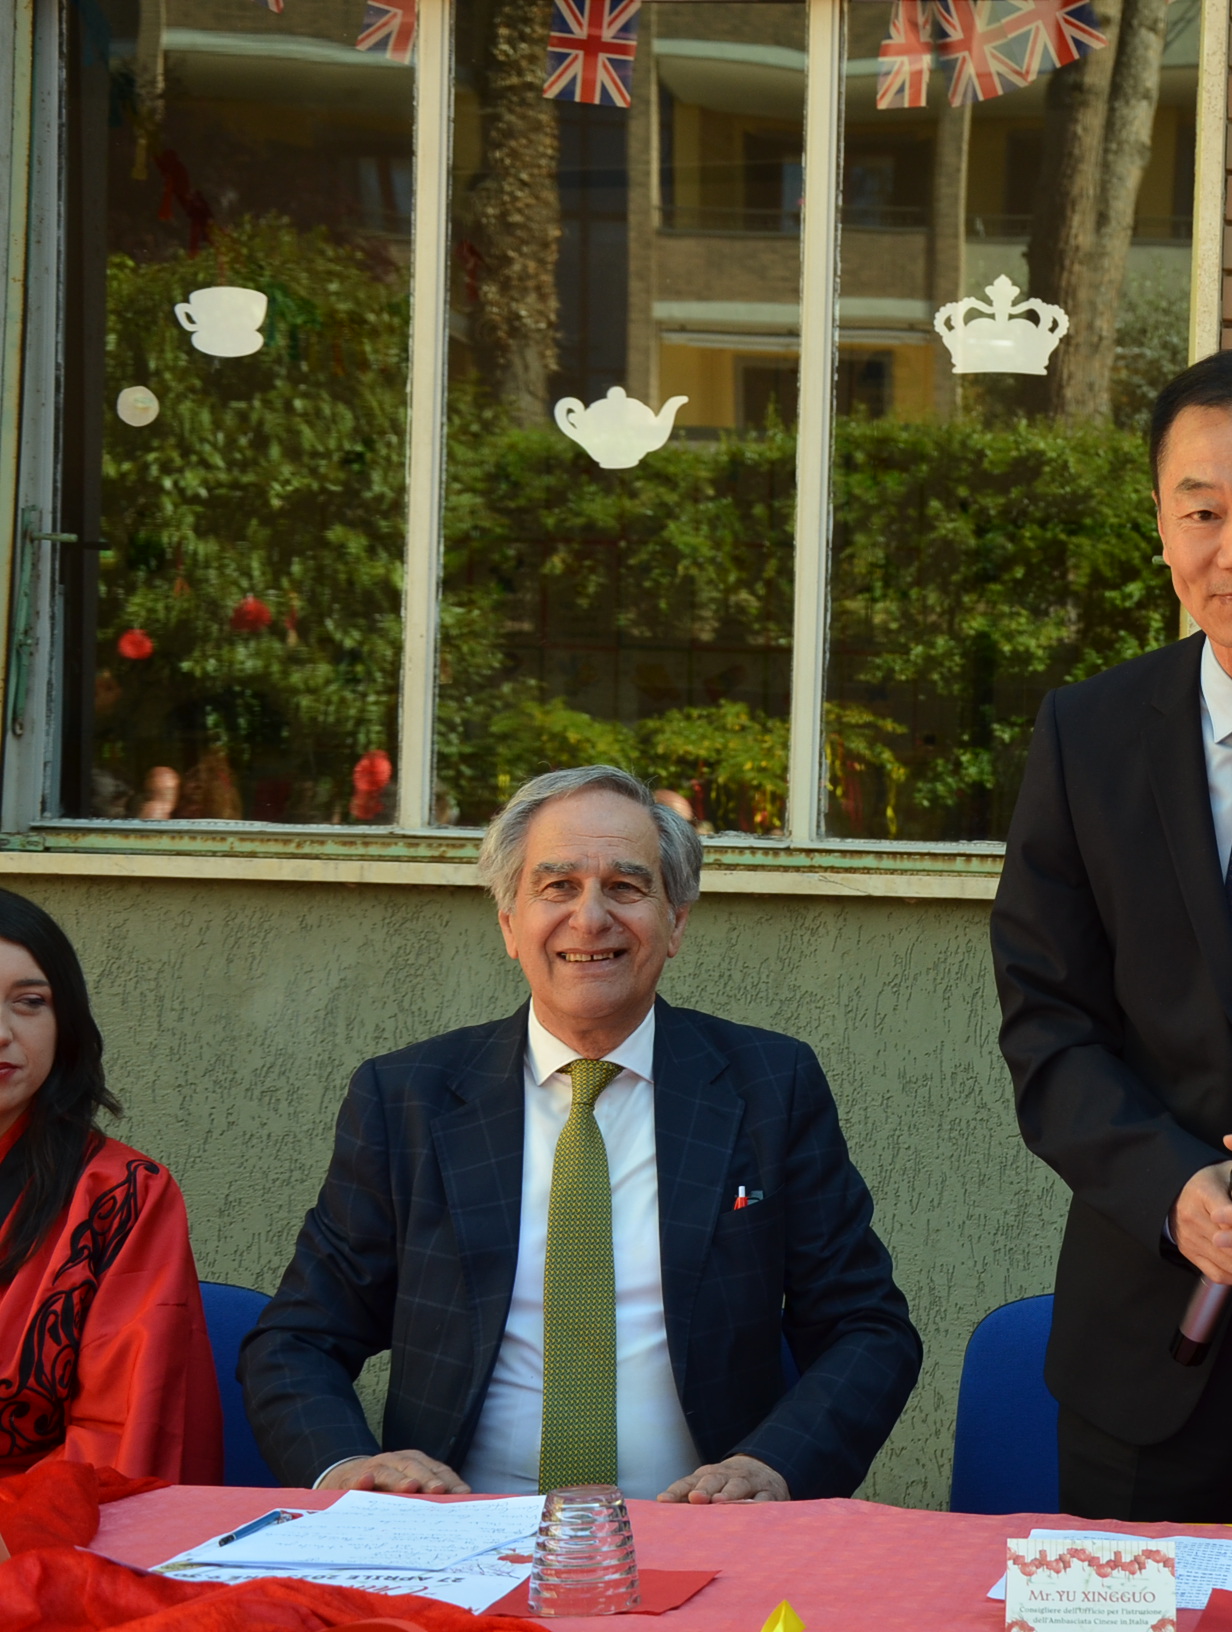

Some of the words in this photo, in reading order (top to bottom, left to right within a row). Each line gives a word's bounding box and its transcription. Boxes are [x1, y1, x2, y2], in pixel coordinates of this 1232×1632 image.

[1081, 1591, 1156, 1603] XINGGUO
[1019, 1607, 1061, 1616] Consigliere
[1032, 1617, 1092, 1625] dell'Ambasciata
